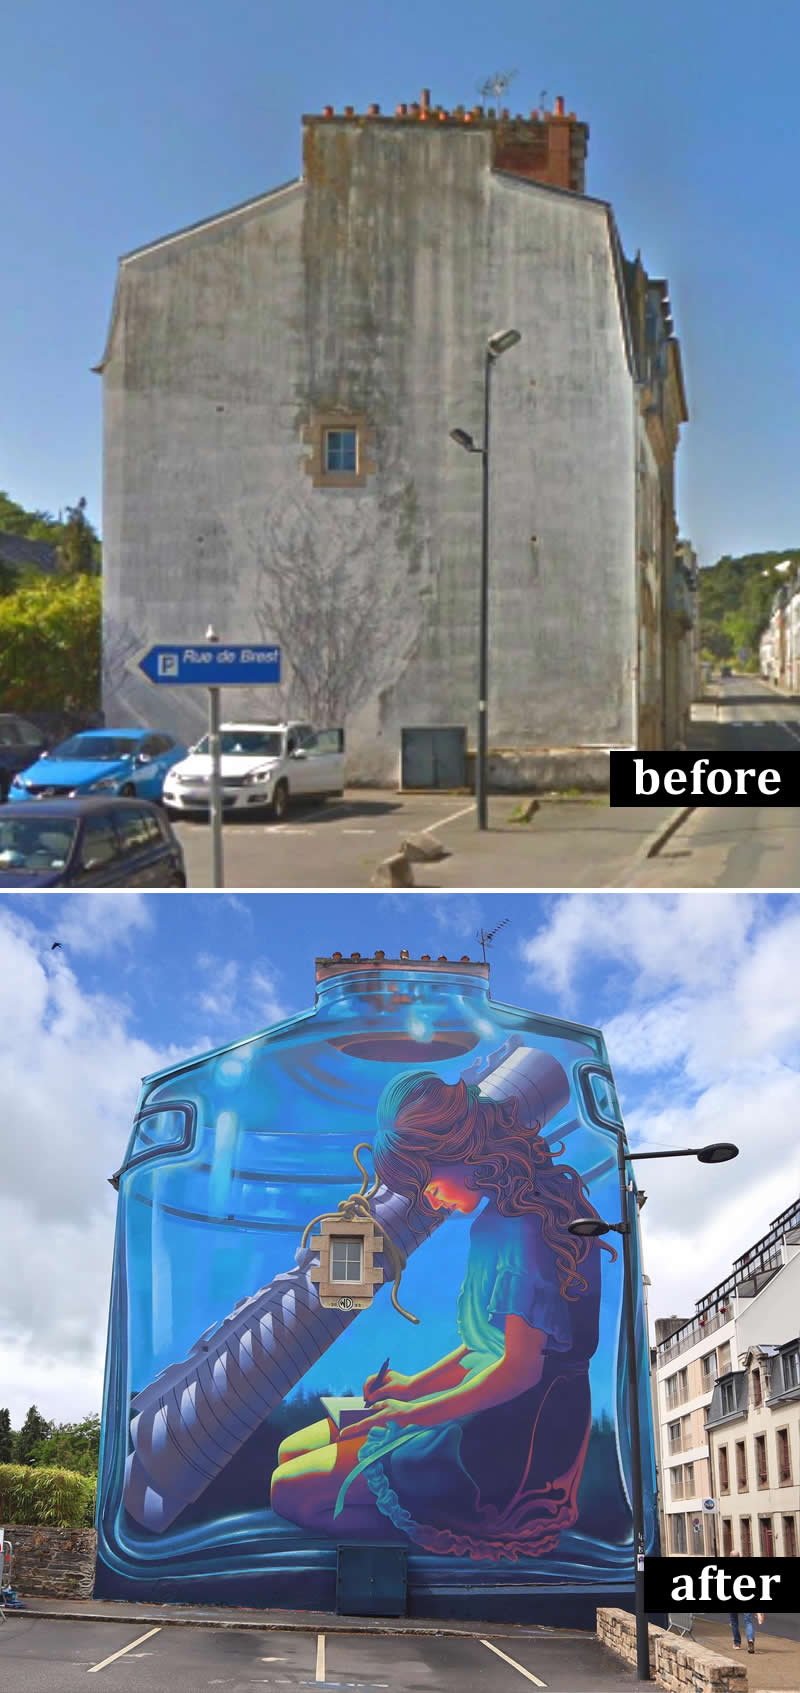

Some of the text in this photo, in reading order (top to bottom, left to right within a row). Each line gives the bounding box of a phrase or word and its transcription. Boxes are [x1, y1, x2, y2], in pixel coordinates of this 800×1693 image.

[183, 649, 278, 663] Rue de Brest
[162, 656, 174, 673] P
